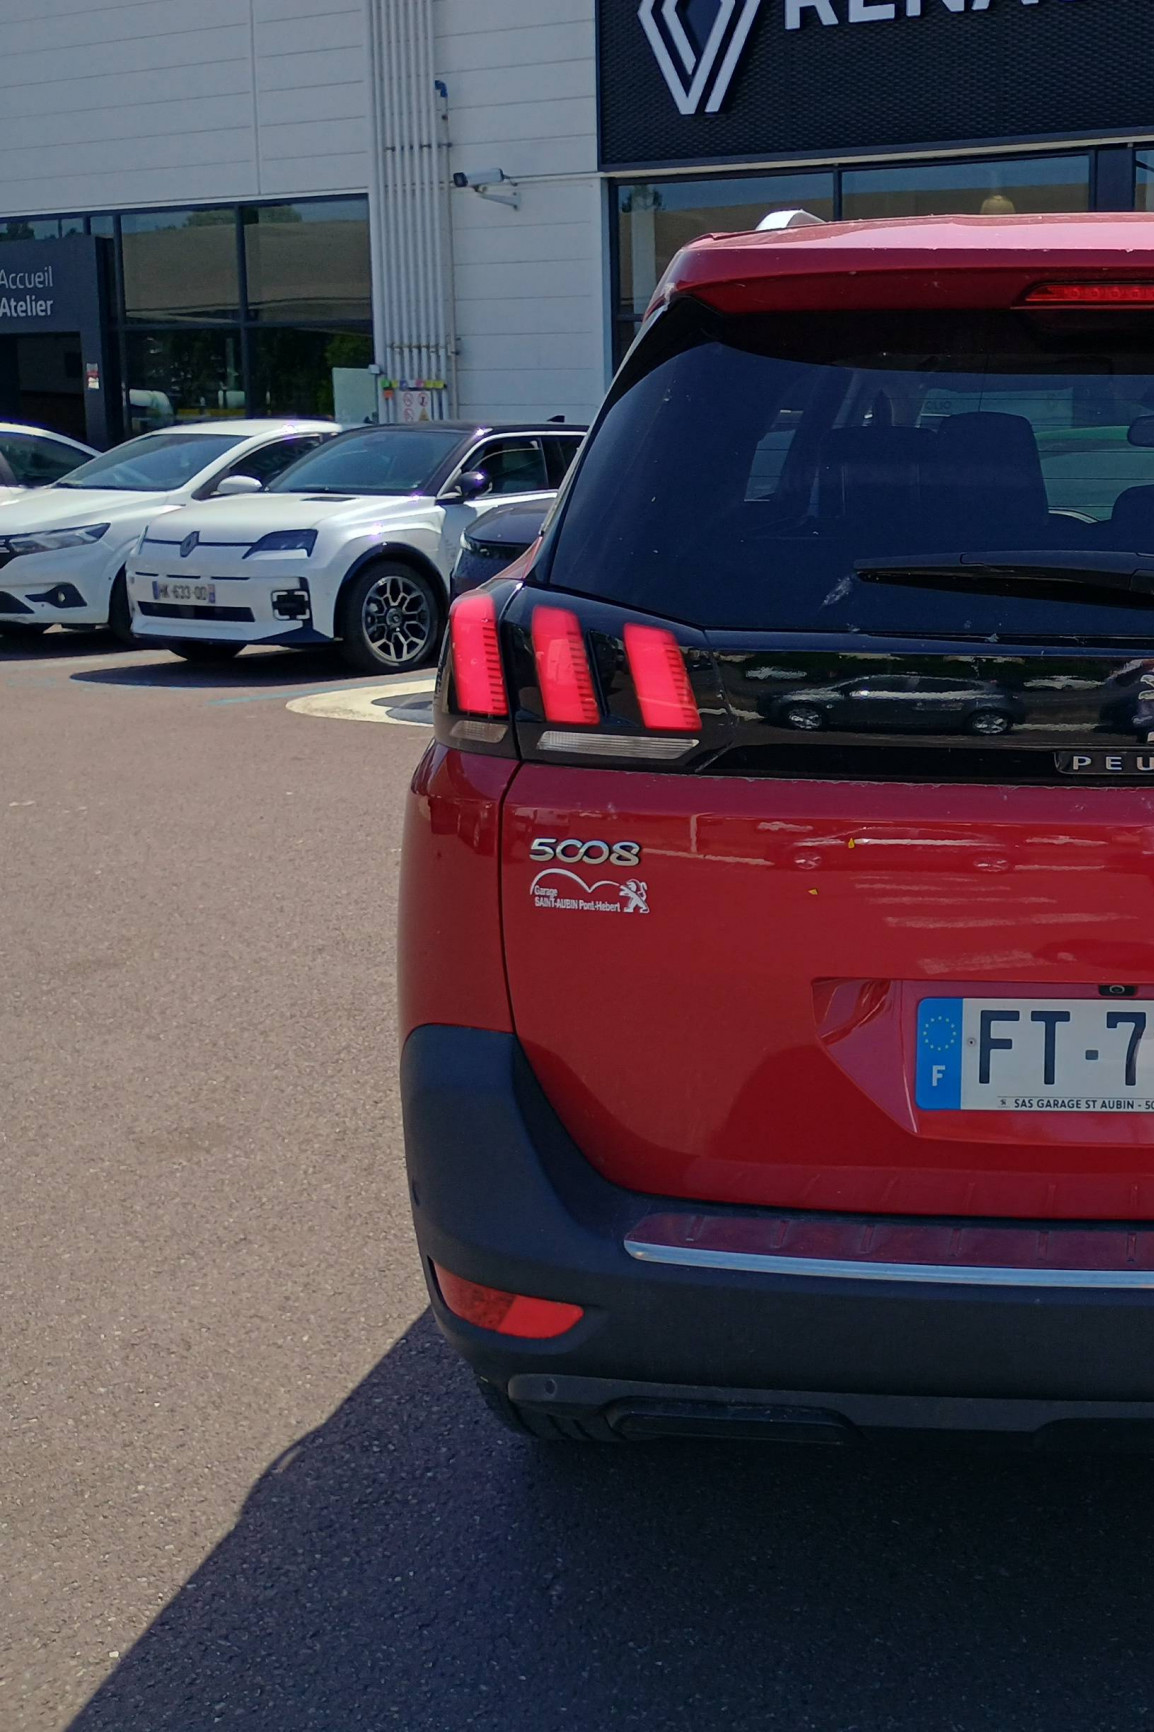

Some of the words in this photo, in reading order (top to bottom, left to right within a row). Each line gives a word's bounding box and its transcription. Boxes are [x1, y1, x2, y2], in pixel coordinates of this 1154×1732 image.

[0, 266, 53, 289] Accueil
[0, 295, 53, 317] Atelier
[530, 838, 640, 866] 5008
[535, 885, 558, 899] Garage
[932, 1065, 946, 1086] F
[1014, 1099, 1033, 1109] SAS
[1036, 1099, 1081, 1109] GARAGE
[1084, 1099, 1097, 1109] ST
[1100, 1100, 1134, 1110] AUBIN
